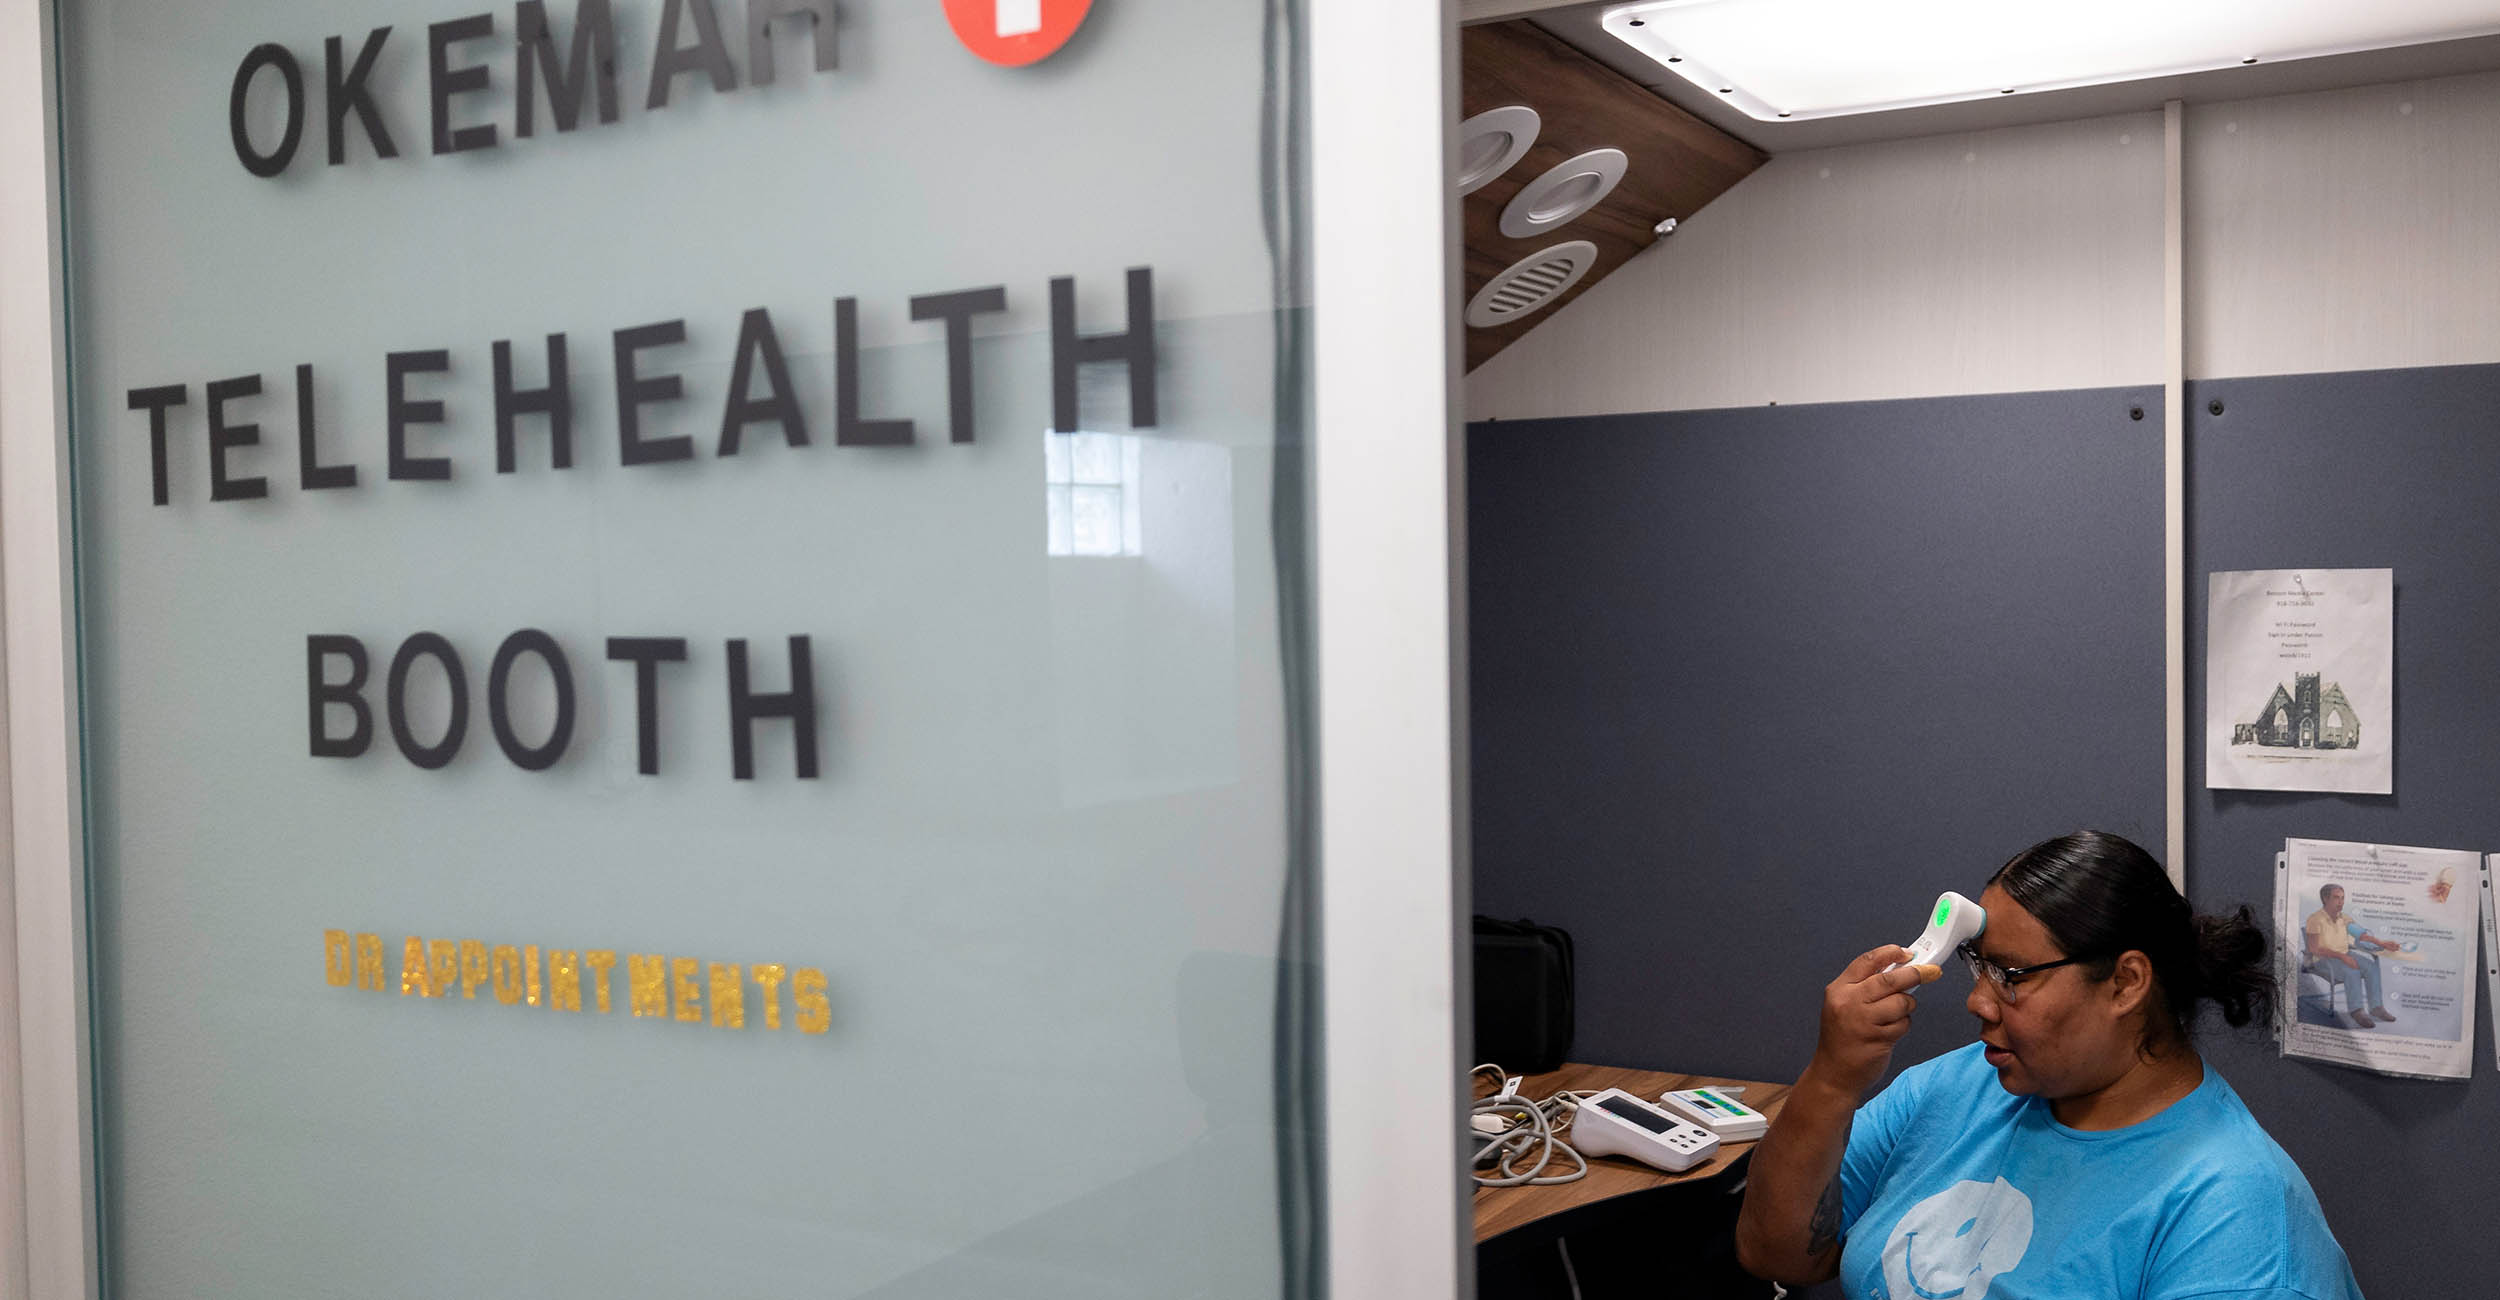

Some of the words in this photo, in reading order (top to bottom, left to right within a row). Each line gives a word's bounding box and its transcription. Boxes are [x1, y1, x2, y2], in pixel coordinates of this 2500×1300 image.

[230, 0, 839, 178] OKEMAH
[127, 266, 1157, 507] TELEHEALTH
[307, 628, 821, 780] BOOTH
[324, 929, 386, 992] DR
[402, 936, 832, 1034] APPOINTMENTS
